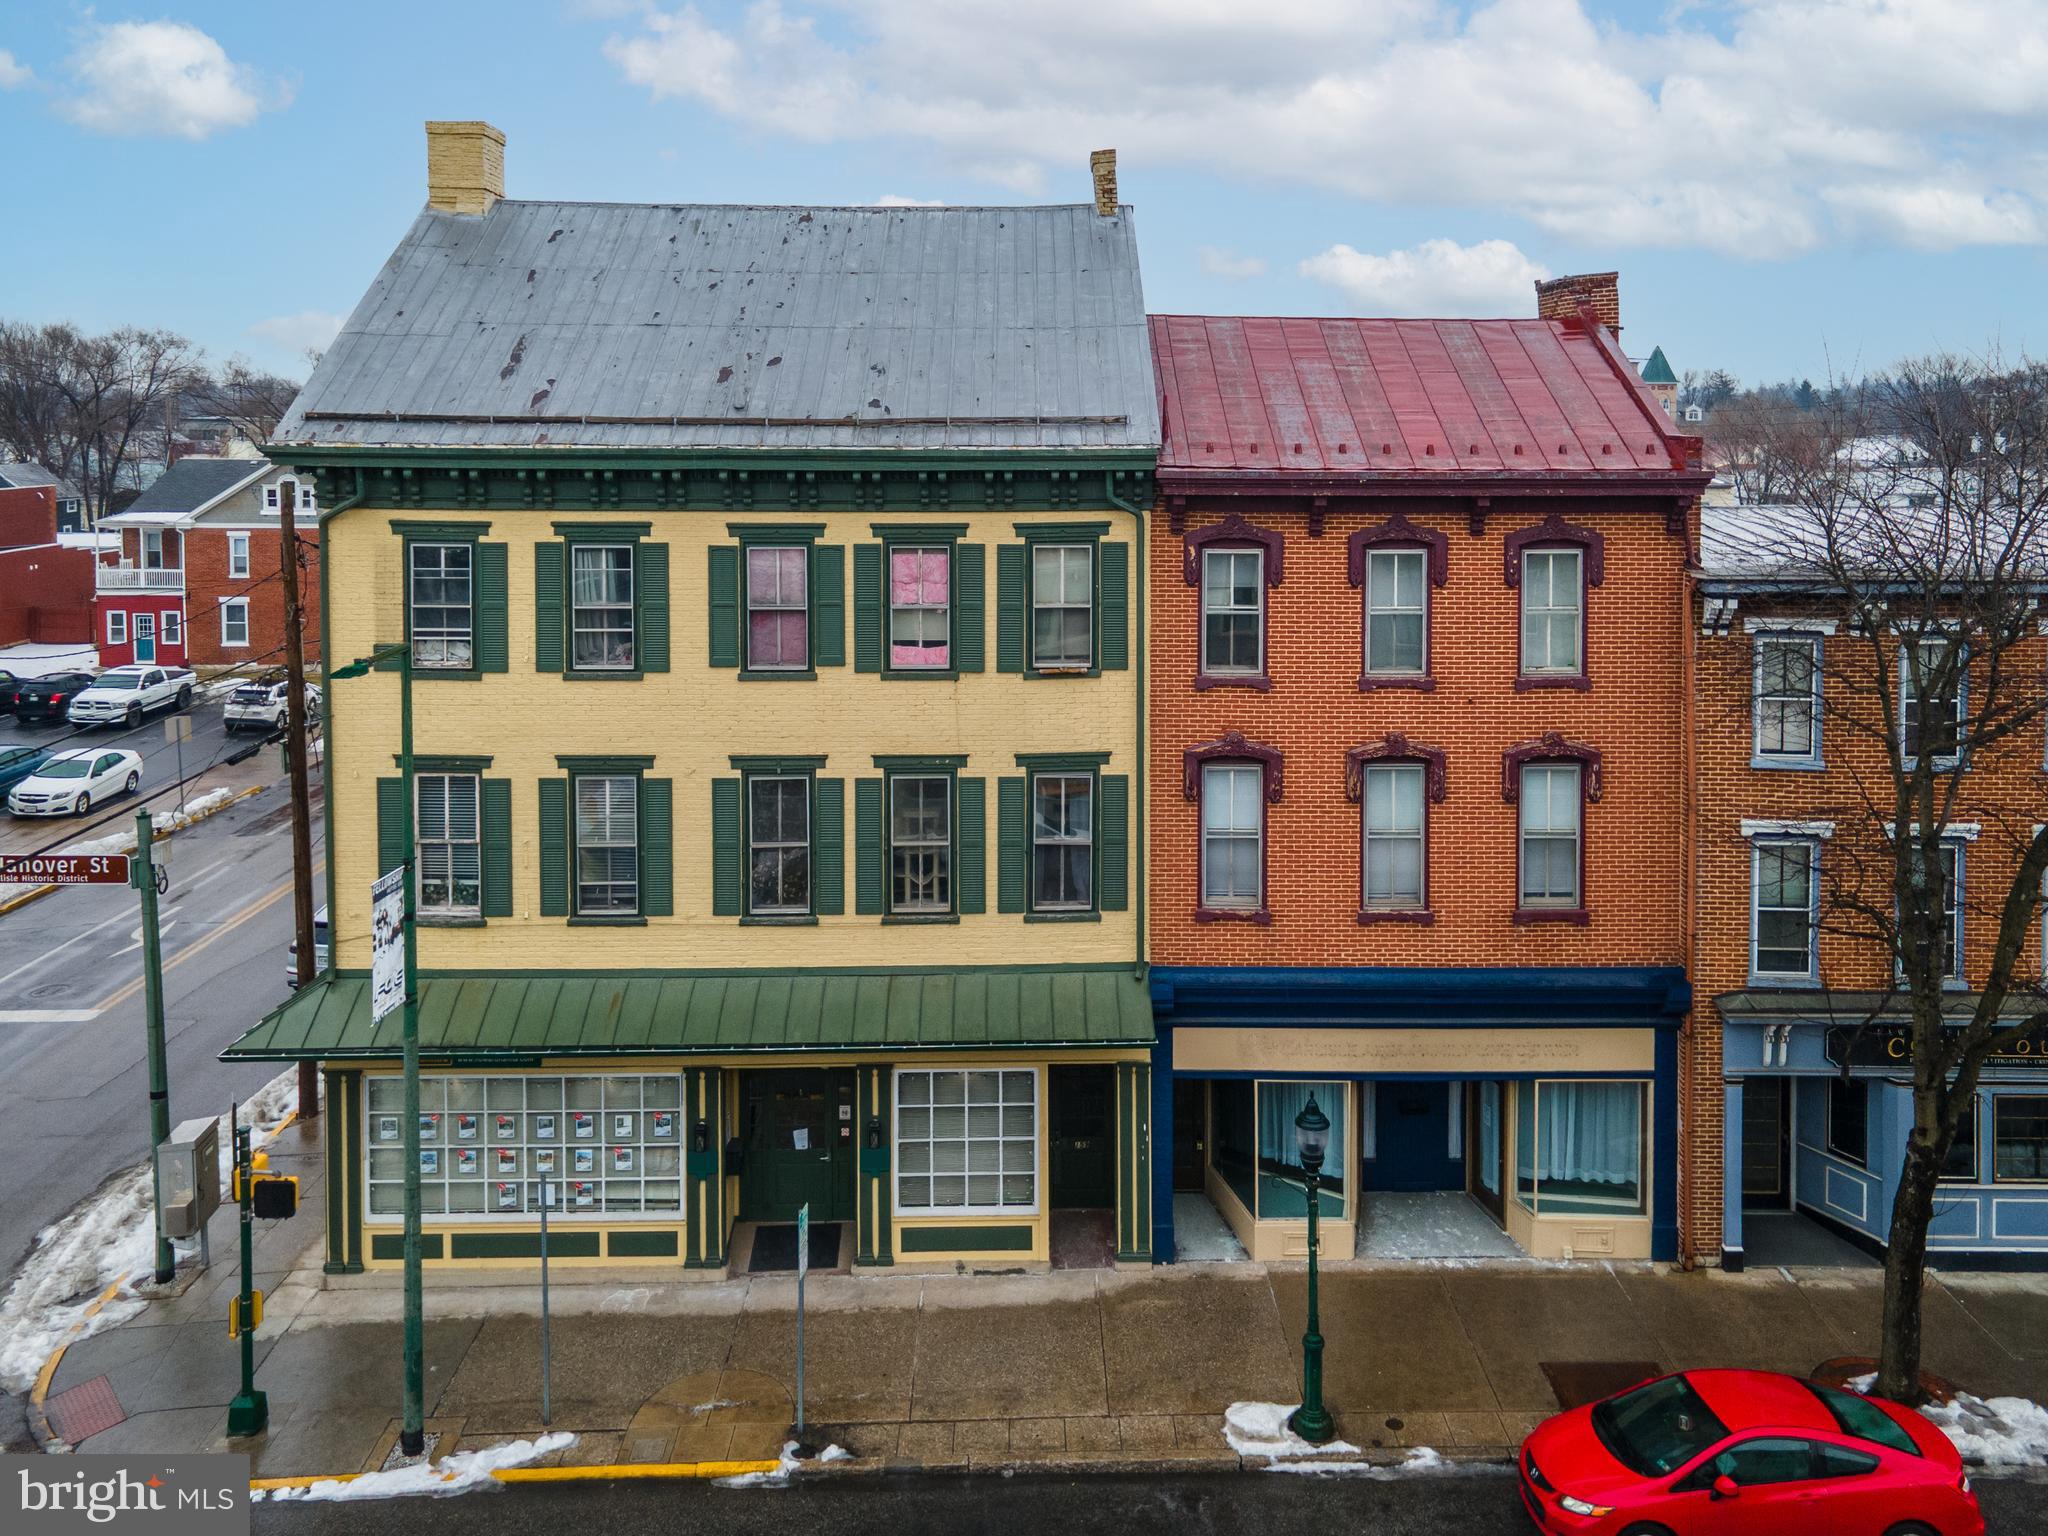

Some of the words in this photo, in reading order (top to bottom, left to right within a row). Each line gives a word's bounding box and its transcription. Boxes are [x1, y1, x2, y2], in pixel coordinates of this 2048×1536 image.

[90, 857, 110, 873] St
[22, 874, 54, 882] Historic
[57, 874, 88, 882] District
